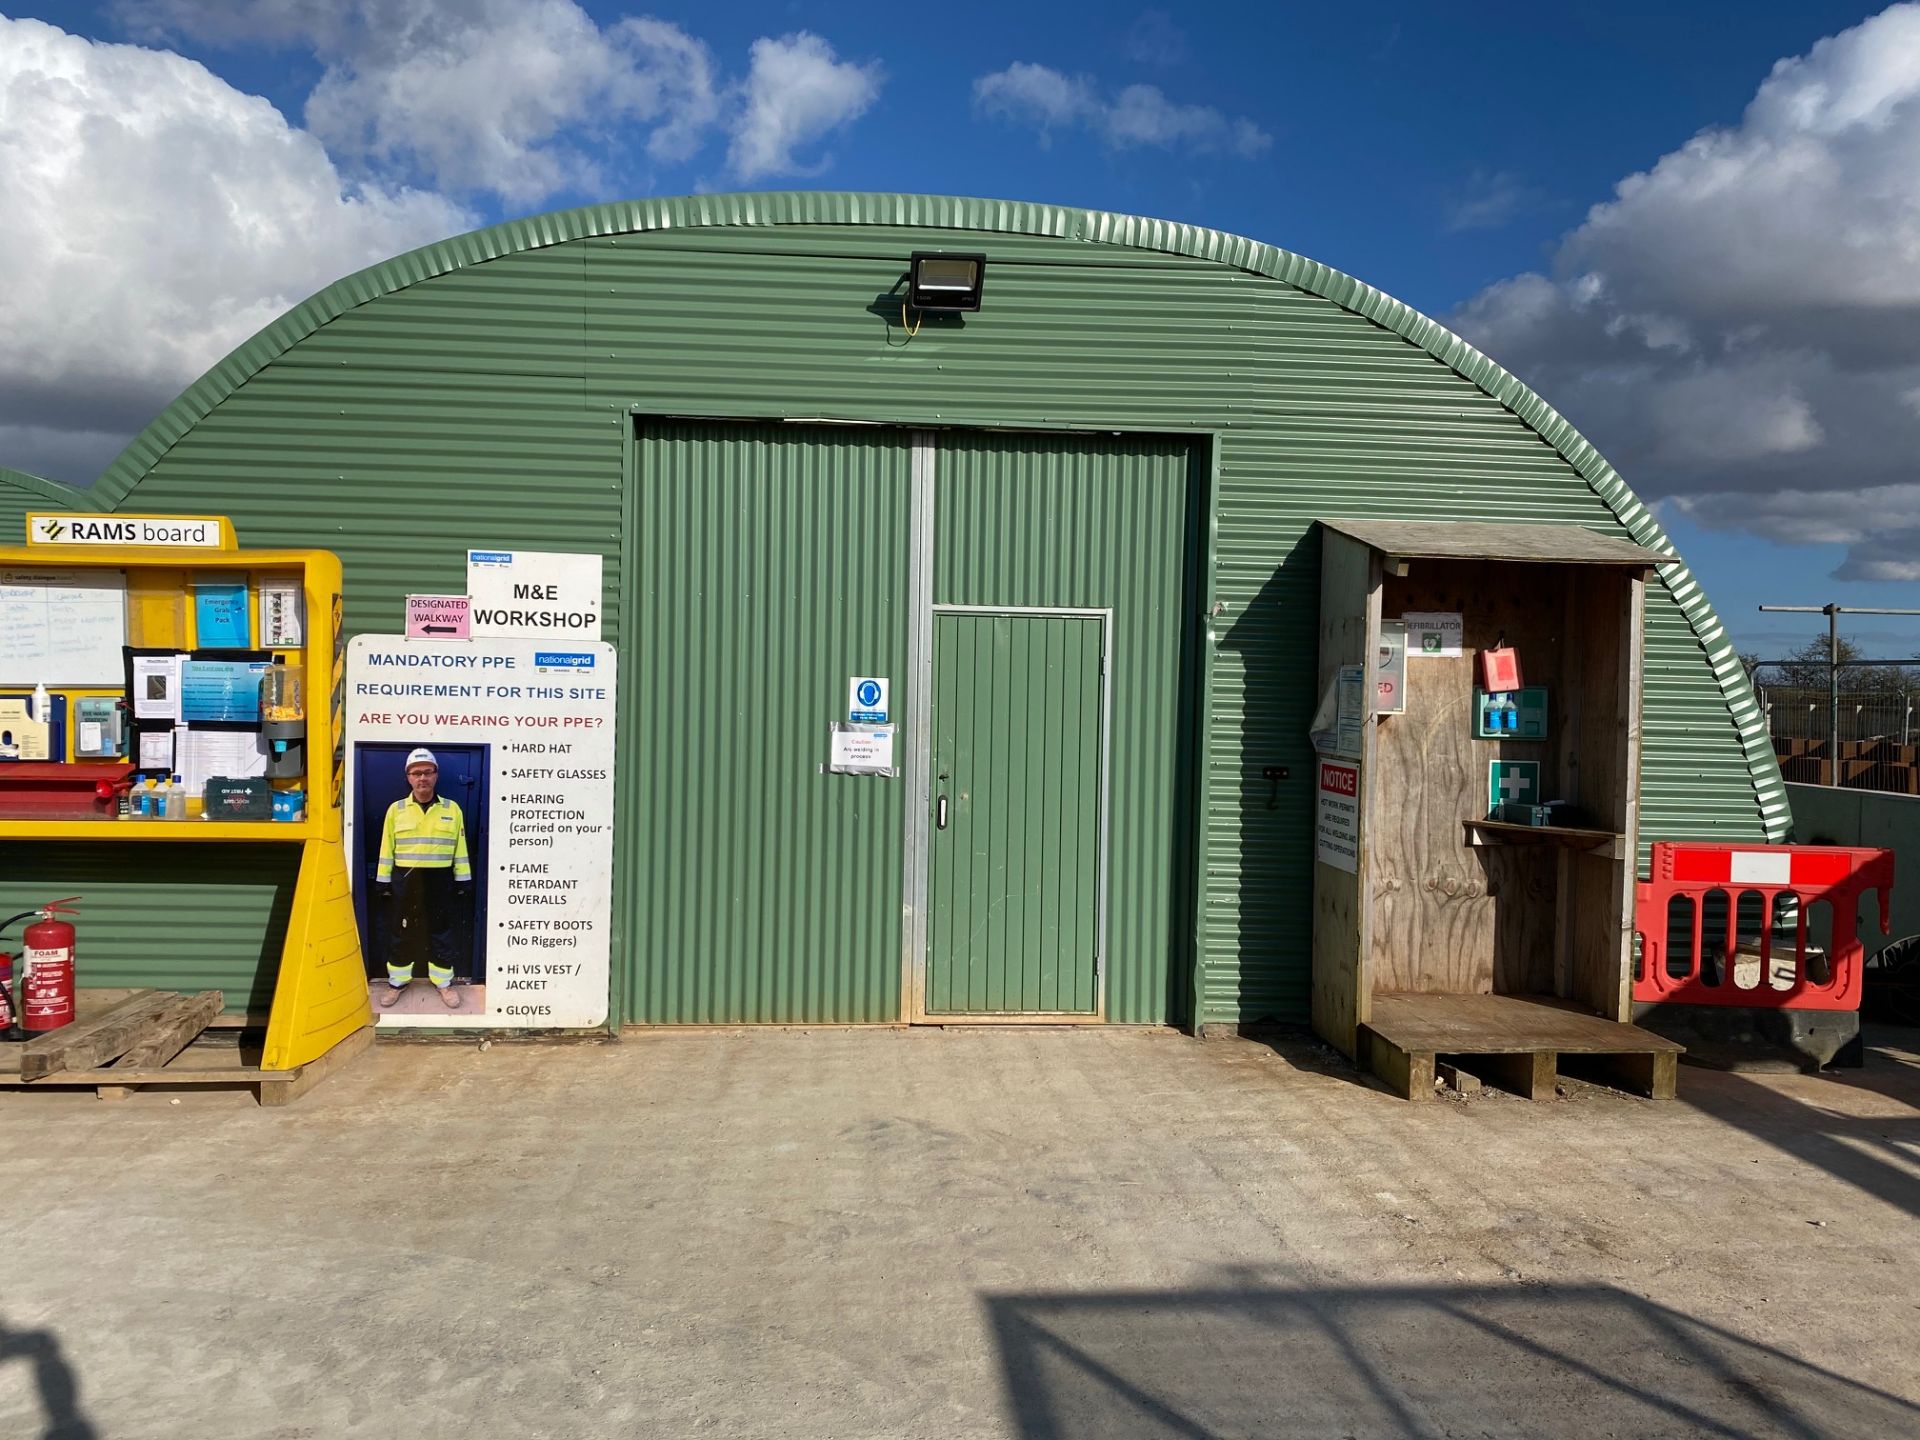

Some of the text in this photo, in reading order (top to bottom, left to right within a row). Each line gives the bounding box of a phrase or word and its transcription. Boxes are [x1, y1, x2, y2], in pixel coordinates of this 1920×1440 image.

[72, 522, 205, 542] RAMS board
[472, 554, 510, 562] nationalgrid
[514, 584, 558, 600] M&E
[204, 598, 239, 606] Emergency
[410, 600, 468, 610] DESIGNATED
[414, 614, 464, 624] WALKWAY
[474, 610, 596, 628] WORKSHOP
[1408, 622, 1460, 630] EFIBRILLATOR
[368, 654, 515, 669] MANDATORY PPE
[538, 655, 591, 666] nationalgrid
[357, 683, 605, 700] REQUIREMENT FOR THIS SITE
[1378, 682, 1393, 693] ED
[359, 713, 603, 728] ARE YOU WEARING YOUR PPE?
[512, 744, 572, 754] HARD HAT
[511, 769, 606, 780] SAFETY GLASSES
[1324, 770, 1353, 791] NOTICE
[510, 794, 564, 804] HEARING
[510, 809, 585, 820] PROTECTION
[509, 822, 602, 836] (carried on your
[509, 836, 553, 848] person)
[509, 864, 549, 874] FLAME
[508, 880, 578, 890] RETARDANT
[508, 894, 567, 905] OVERALLS
[508, 920, 592, 931] SAFETY BOOTS
[507, 936, 577, 948] (No Riggers)
[507, 964, 581, 976] Hi VIS VEST /
[506, 980, 547, 990] JACKET
[506, 1005, 551, 1015] GLOVES
